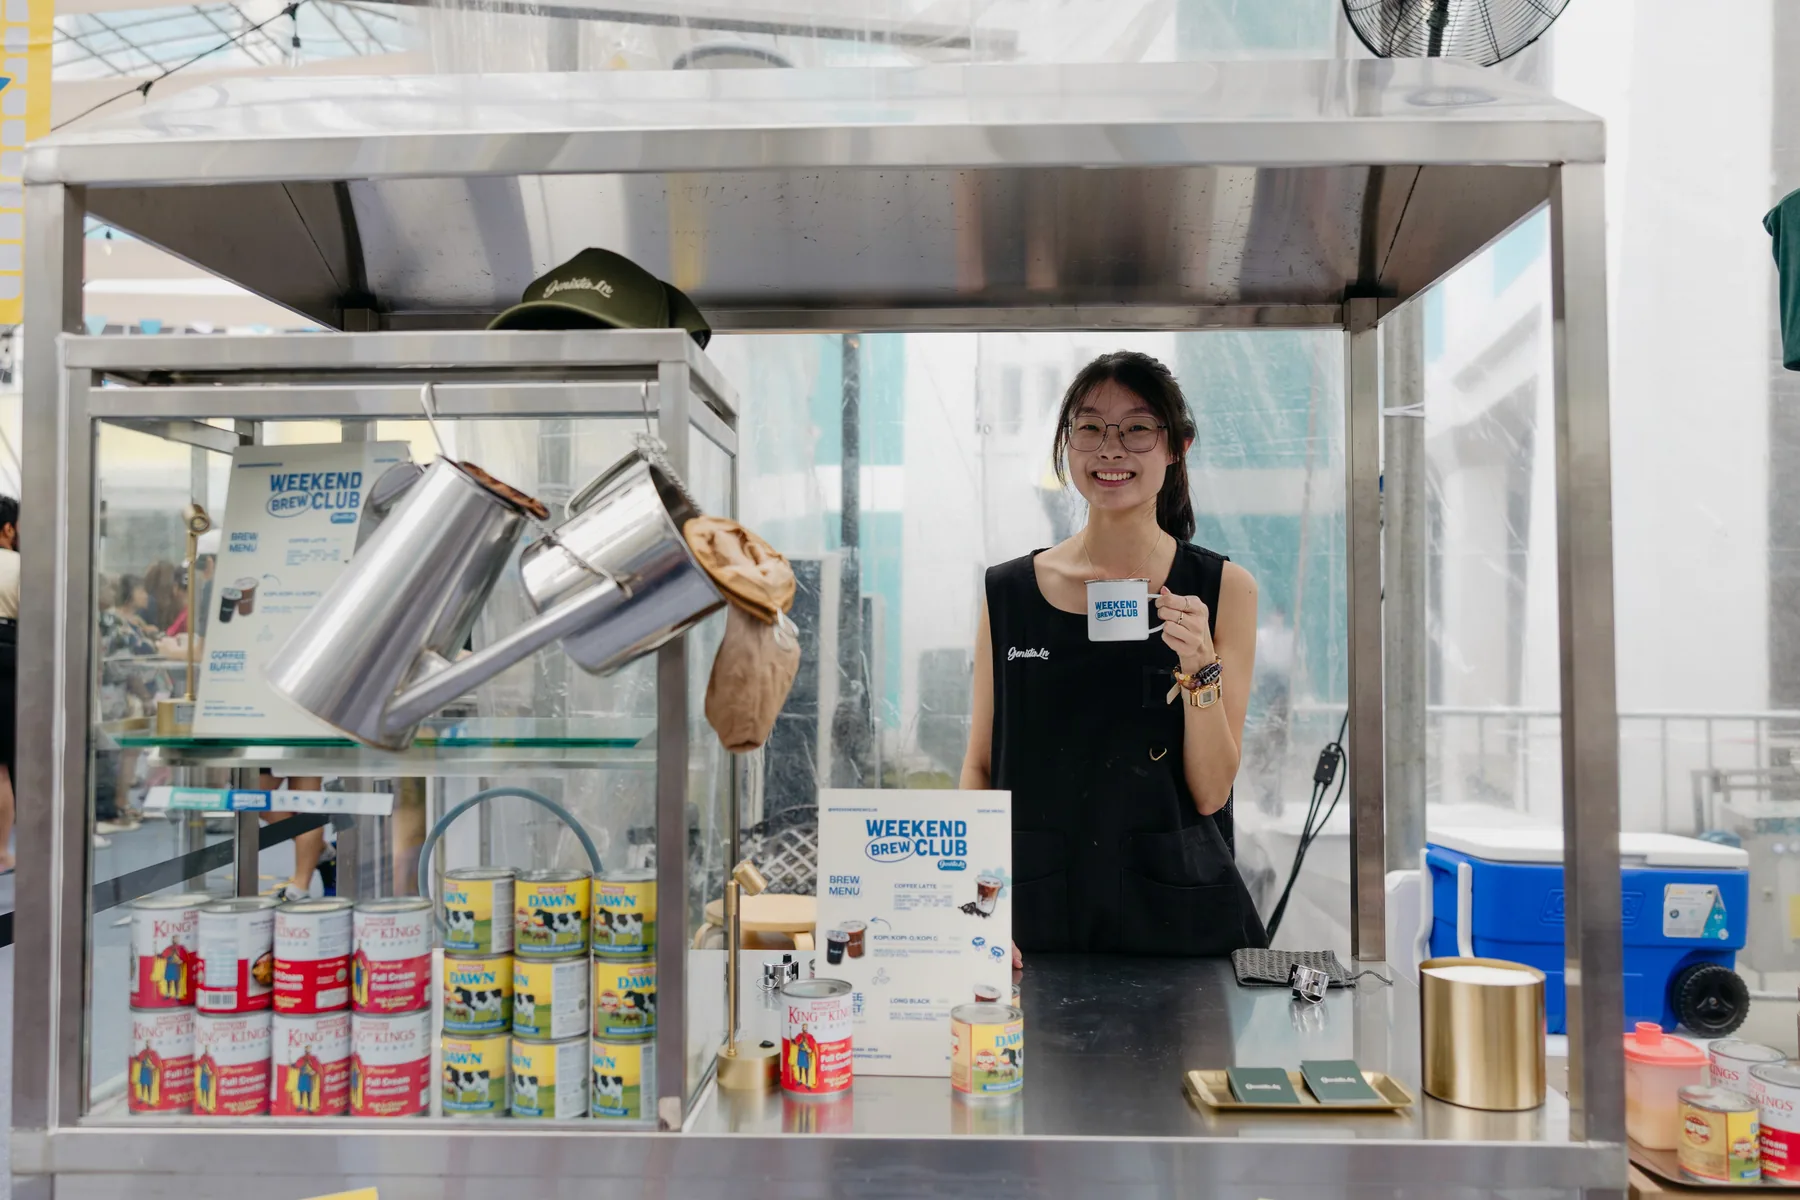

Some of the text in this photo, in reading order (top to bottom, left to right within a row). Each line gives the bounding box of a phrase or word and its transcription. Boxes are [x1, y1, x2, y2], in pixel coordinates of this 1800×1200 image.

[270, 472, 363, 492] WEEKEND
[271, 492, 360, 512] BREW CLUB
[231, 532, 258, 541] BREW
[229, 544, 257, 553] MENU
[1095, 600, 1138, 610] WEEKEND
[1097, 608, 1138, 618] BREW CLUB
[866, 819, 967, 838] WEEKEND
[871, 839, 967, 857] BREW CLUB
[829, 875, 860, 884] BREW
[444, 892, 468, 905] WN
[829, 887, 860, 895] MENU
[528, 893, 577, 907] DAWN
[153, 920, 191, 938] KING
[380, 925, 422, 939] KINGS
[450, 971, 496, 985] DAWN
[617, 975, 656, 990] DAW
[788, 1005, 818, 1024] KING
[132, 1022, 164, 1040] KING
[231, 1026, 272, 1043] KINGS
[288, 1028, 323, 1047] KING
[375, 1029, 416, 1044] KINGS
[995, 1031, 1023, 1048] DAW
[1755, 1093, 1793, 1112] KINGS
[1761, 1136, 1788, 1151] Cream
